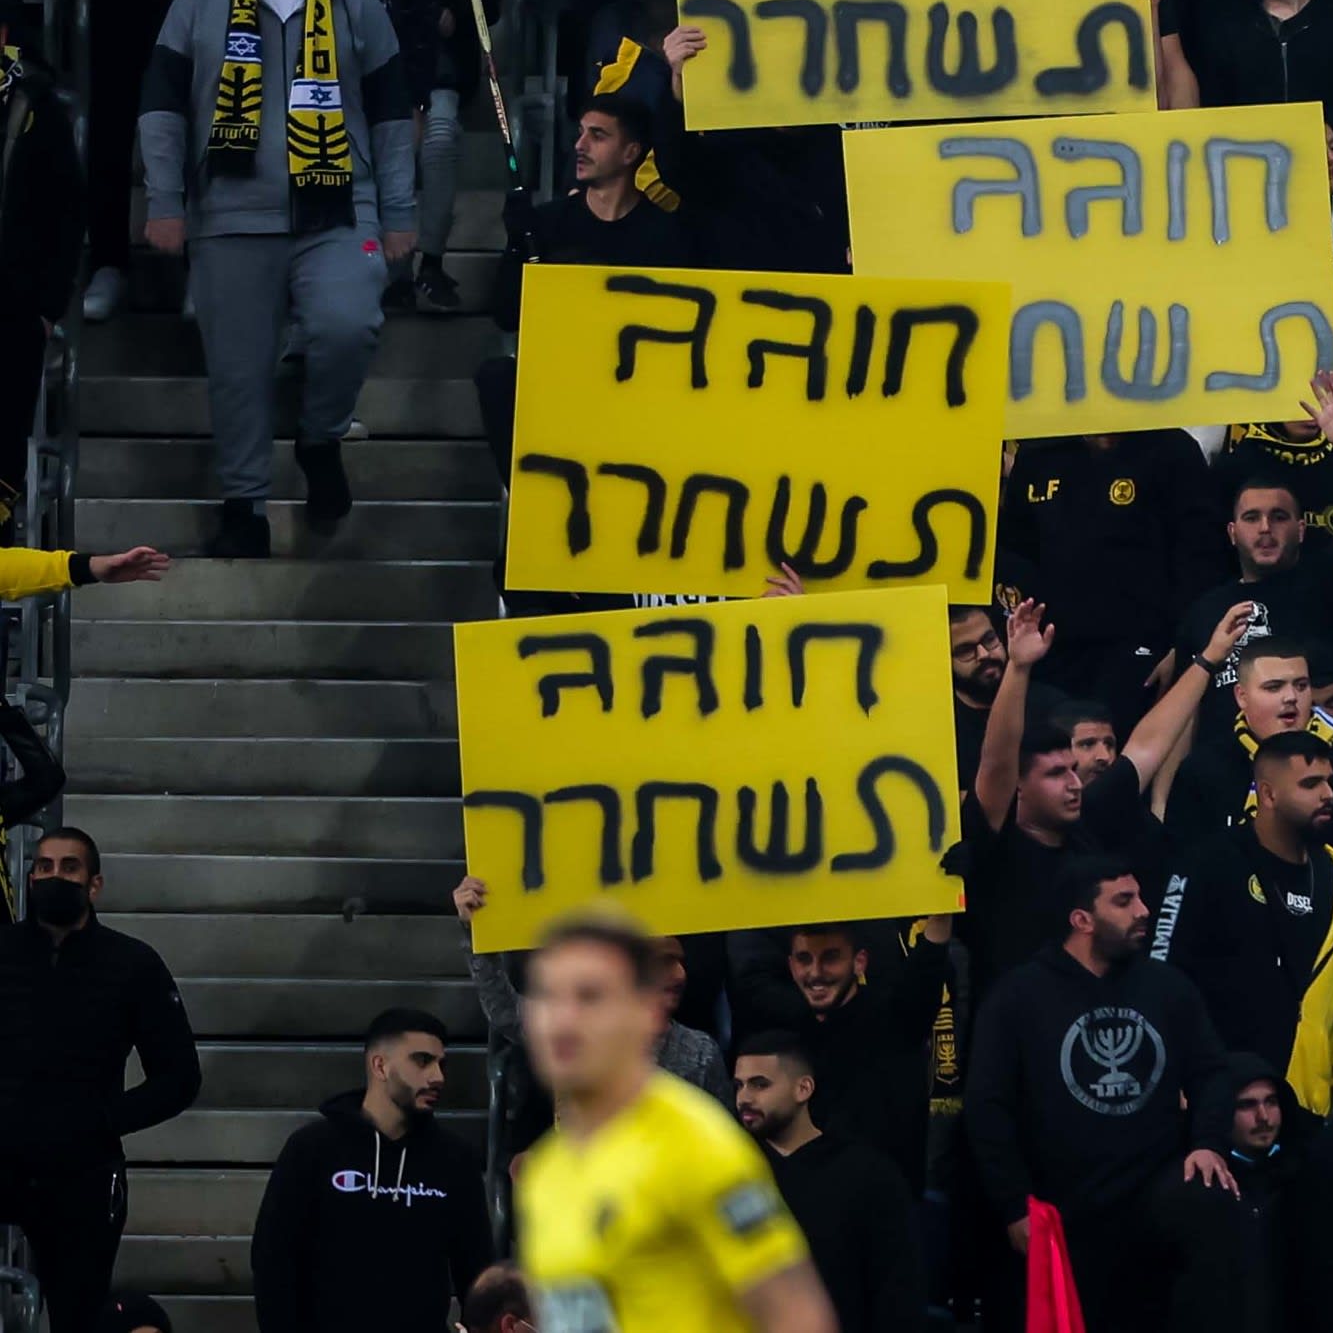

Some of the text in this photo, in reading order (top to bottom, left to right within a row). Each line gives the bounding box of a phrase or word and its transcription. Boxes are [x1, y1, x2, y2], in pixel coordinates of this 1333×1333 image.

[605, 275, 979, 407] חוגג
[1027, 477, 1061, 504] L.F
[519, 619, 882, 718] חוגג
[463, 755, 947, 891] תשחרר
[330, 1168, 448, 1208] Champion
